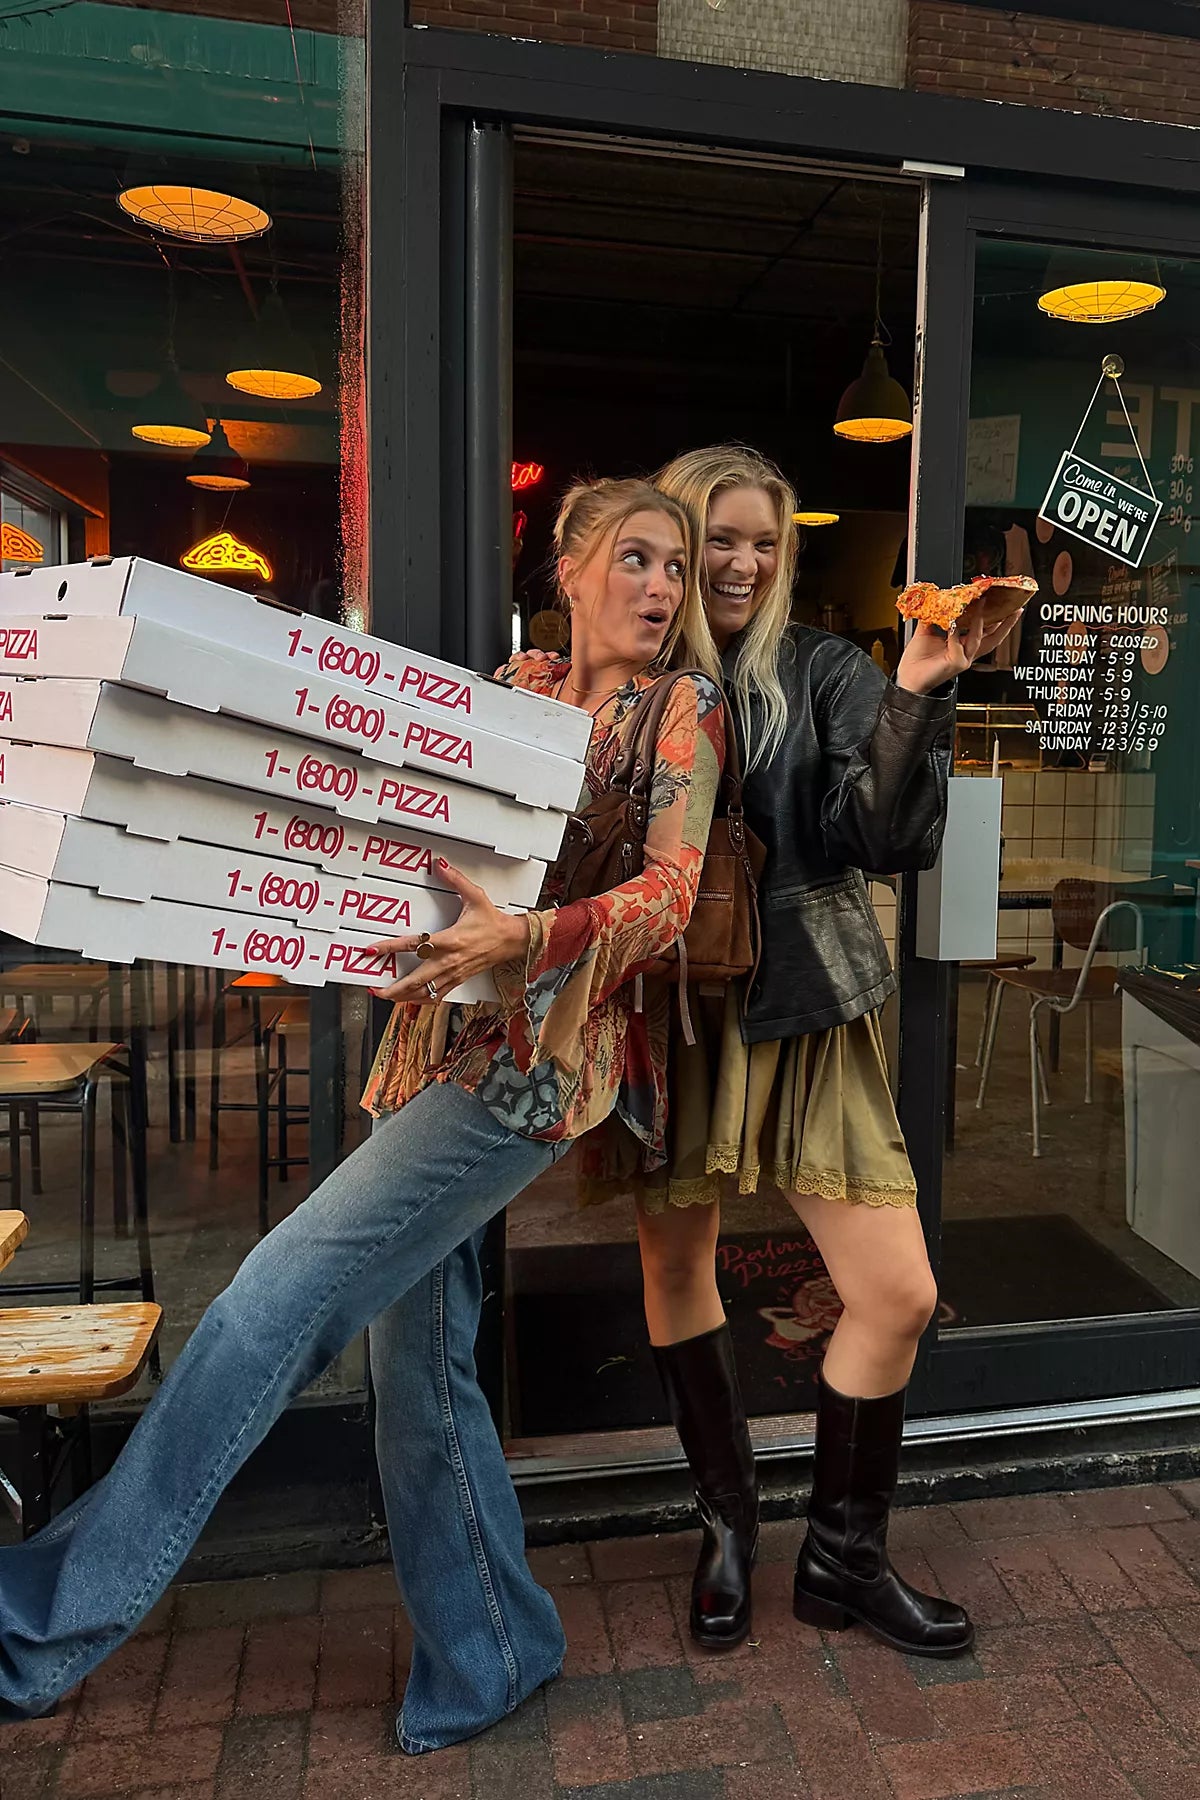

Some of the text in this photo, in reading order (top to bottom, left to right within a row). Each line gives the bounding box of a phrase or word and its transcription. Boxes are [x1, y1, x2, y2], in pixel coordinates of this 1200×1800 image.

[1062, 463, 1101, 493] Come
[1103, 480, 1117, 498] in
[1117, 498, 1149, 523] WE'RE
[1057, 490, 1139, 555] OPEN
[1040, 603, 1168, 625] OPENING HOURS
[1043, 633, 1098, 647] MONDAY
[1038, 650, 1097, 665] TUESDAY
[1013, 666, 1096, 682] WEDNESDAY
[398, 665, 472, 715] PIZZA
[1026, 686, 1094, 700] THURSDAY
[1047, 703, 1093, 717] FRIDAY
[1025, 720, 1092, 735] SATURDAY
[403, 721, 473, 769] PIZZA
[1039, 736, 1092, 750] SUNDAY
[377, 778, 450, 823] PIZZA
[362, 835, 433, 875] PIZZA
[338, 889, 411, 927] PIZZA
